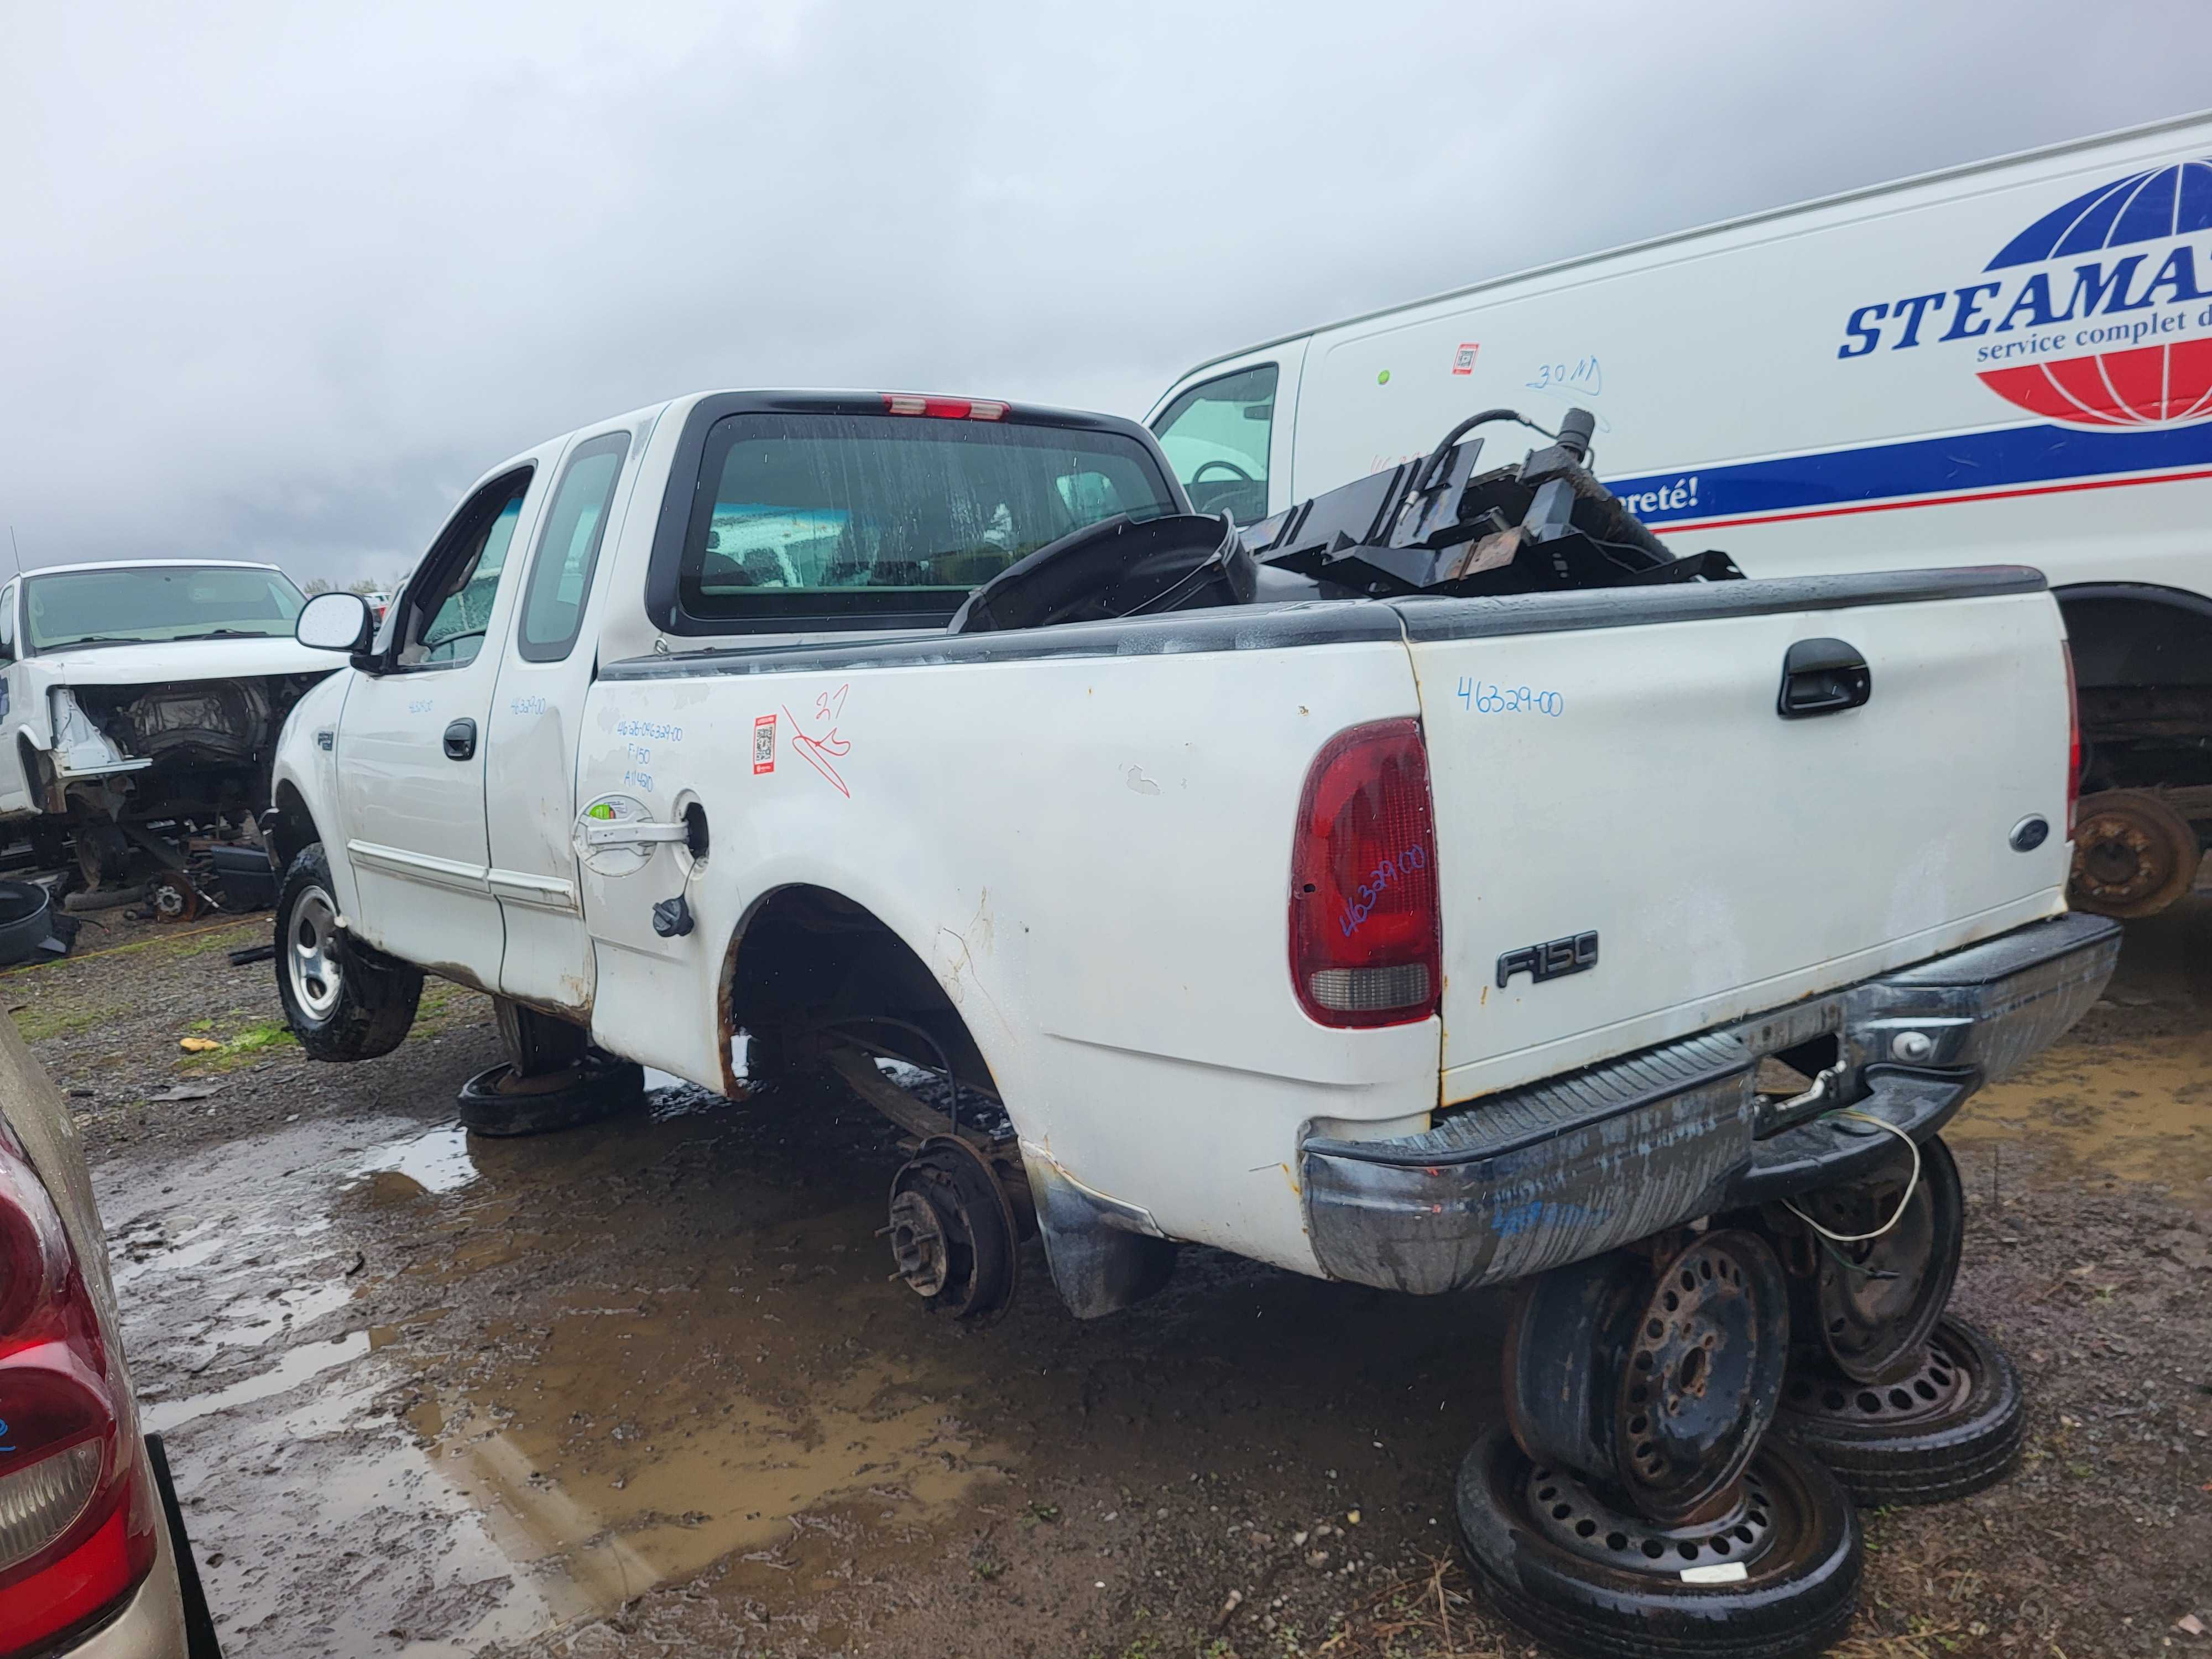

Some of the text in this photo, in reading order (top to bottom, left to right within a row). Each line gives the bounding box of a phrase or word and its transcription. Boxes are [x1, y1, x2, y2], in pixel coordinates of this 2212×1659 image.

[1837, 246, 2212, 359] STEAMA
[1976, 333, 2066, 363] service
[2076, 311, 2187, 346] complet
[1617, 476, 1699, 514] reté!
[1457, 676, 1563, 717] 46329-00
